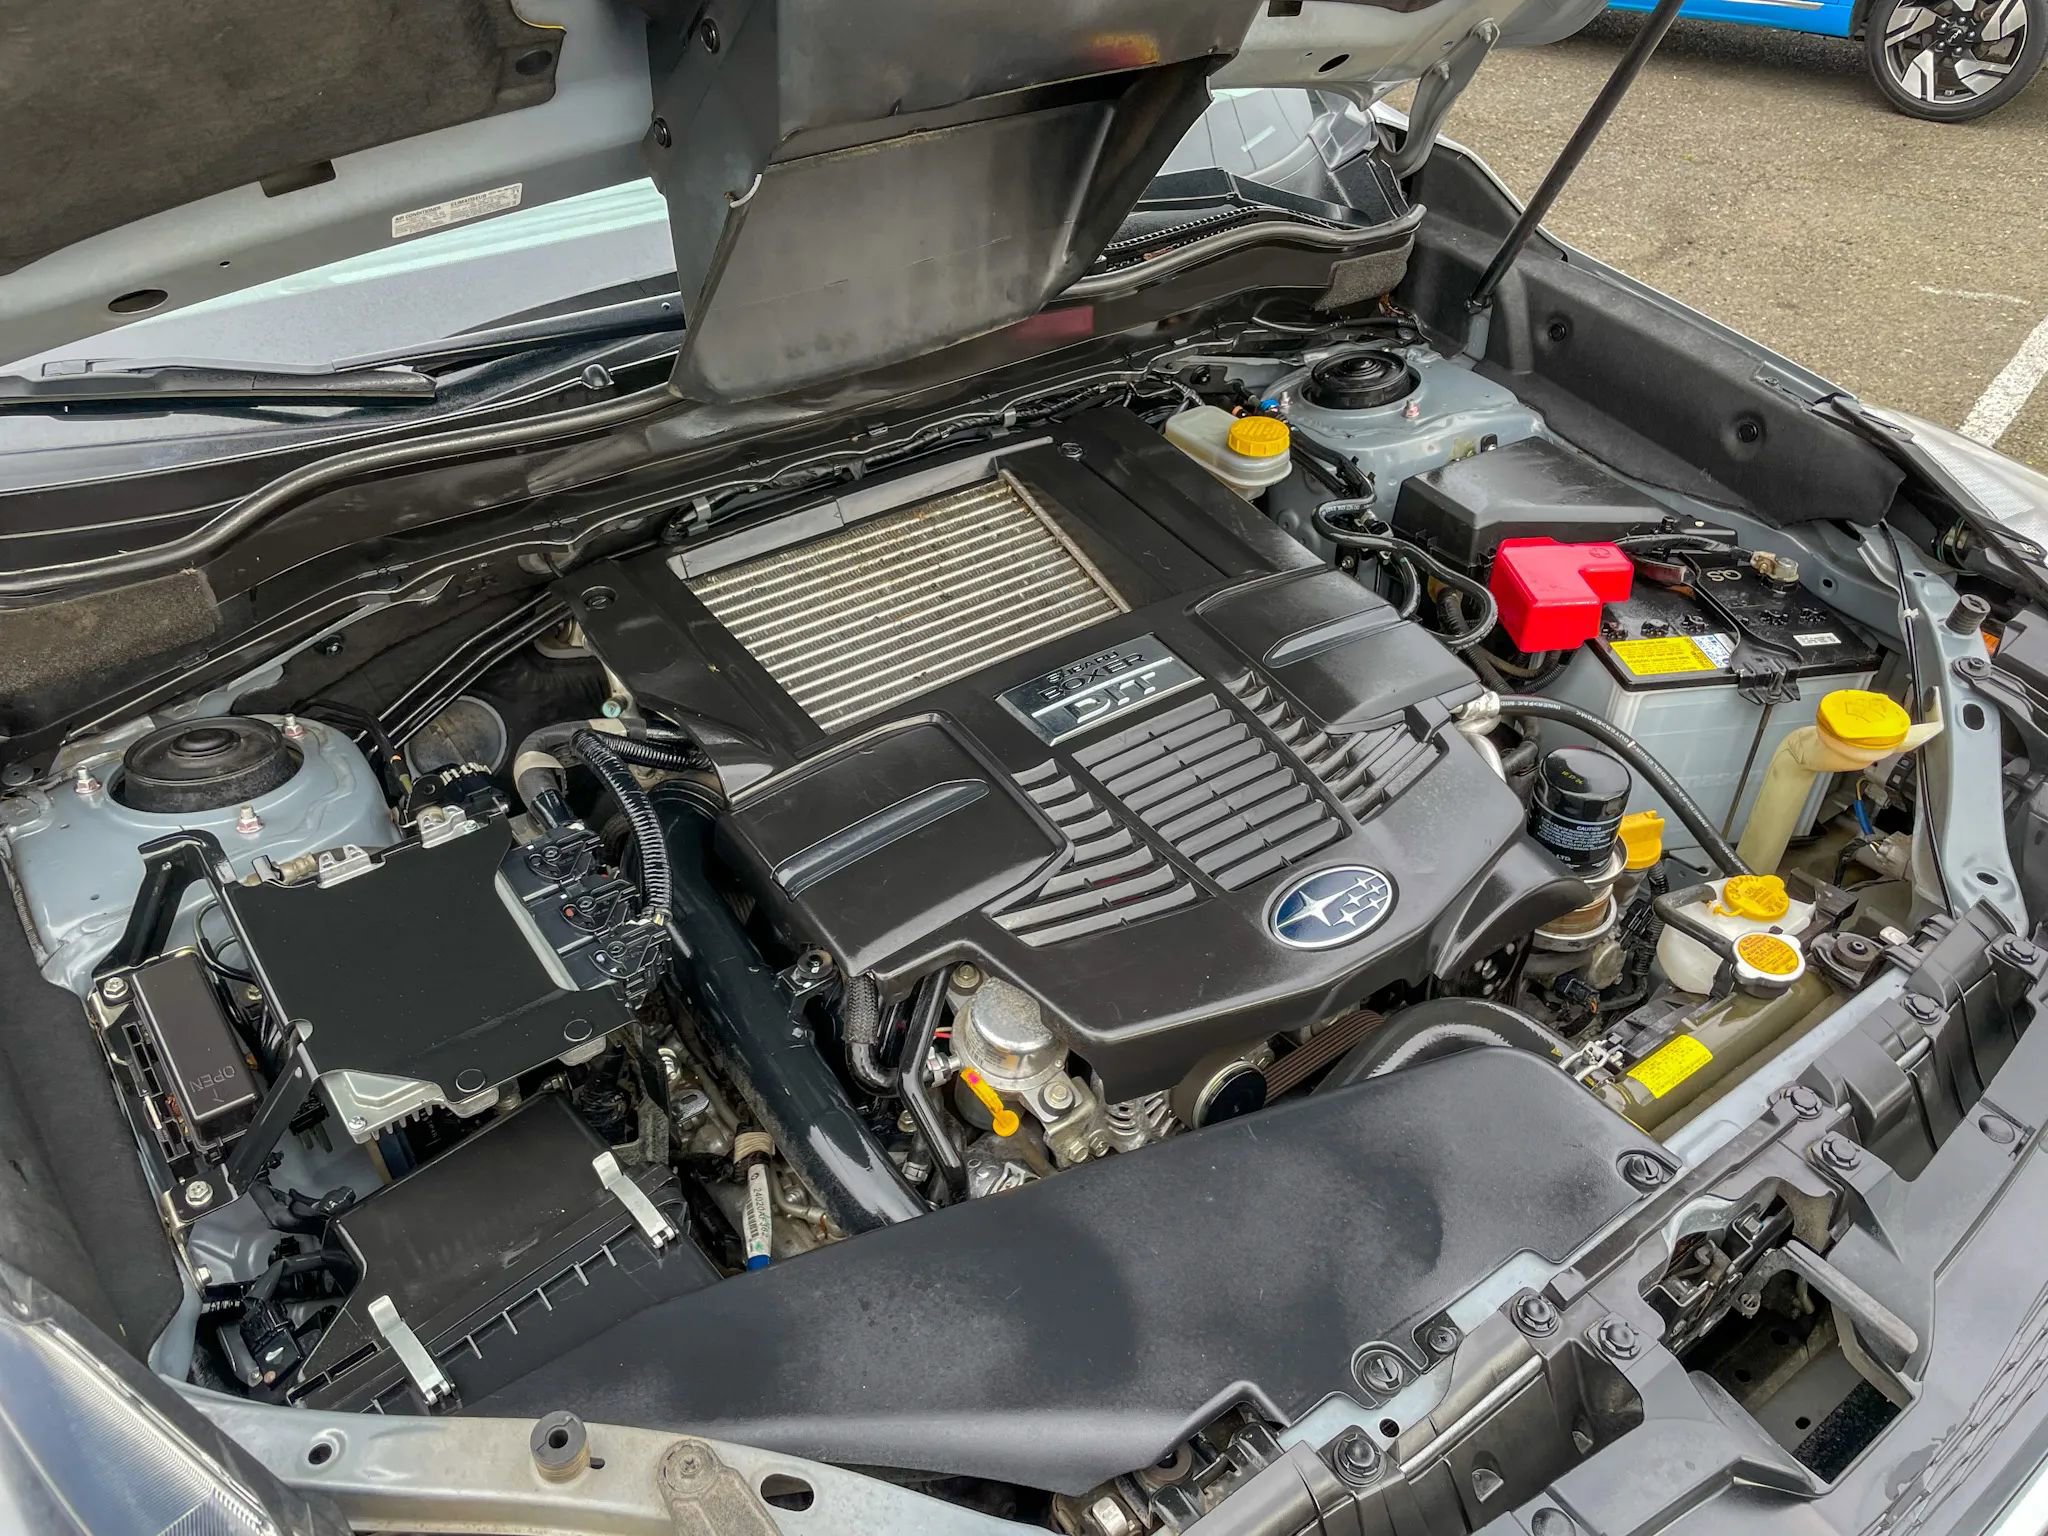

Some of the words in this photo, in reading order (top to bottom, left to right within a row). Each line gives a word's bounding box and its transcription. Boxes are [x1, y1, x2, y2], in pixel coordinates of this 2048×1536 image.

[1039, 653, 1145, 700] BOXER
[1047, 652, 1118, 683] SUBARU
[1064, 672, 1156, 724] DIT
[189, 1066, 235, 1092] OPEN
